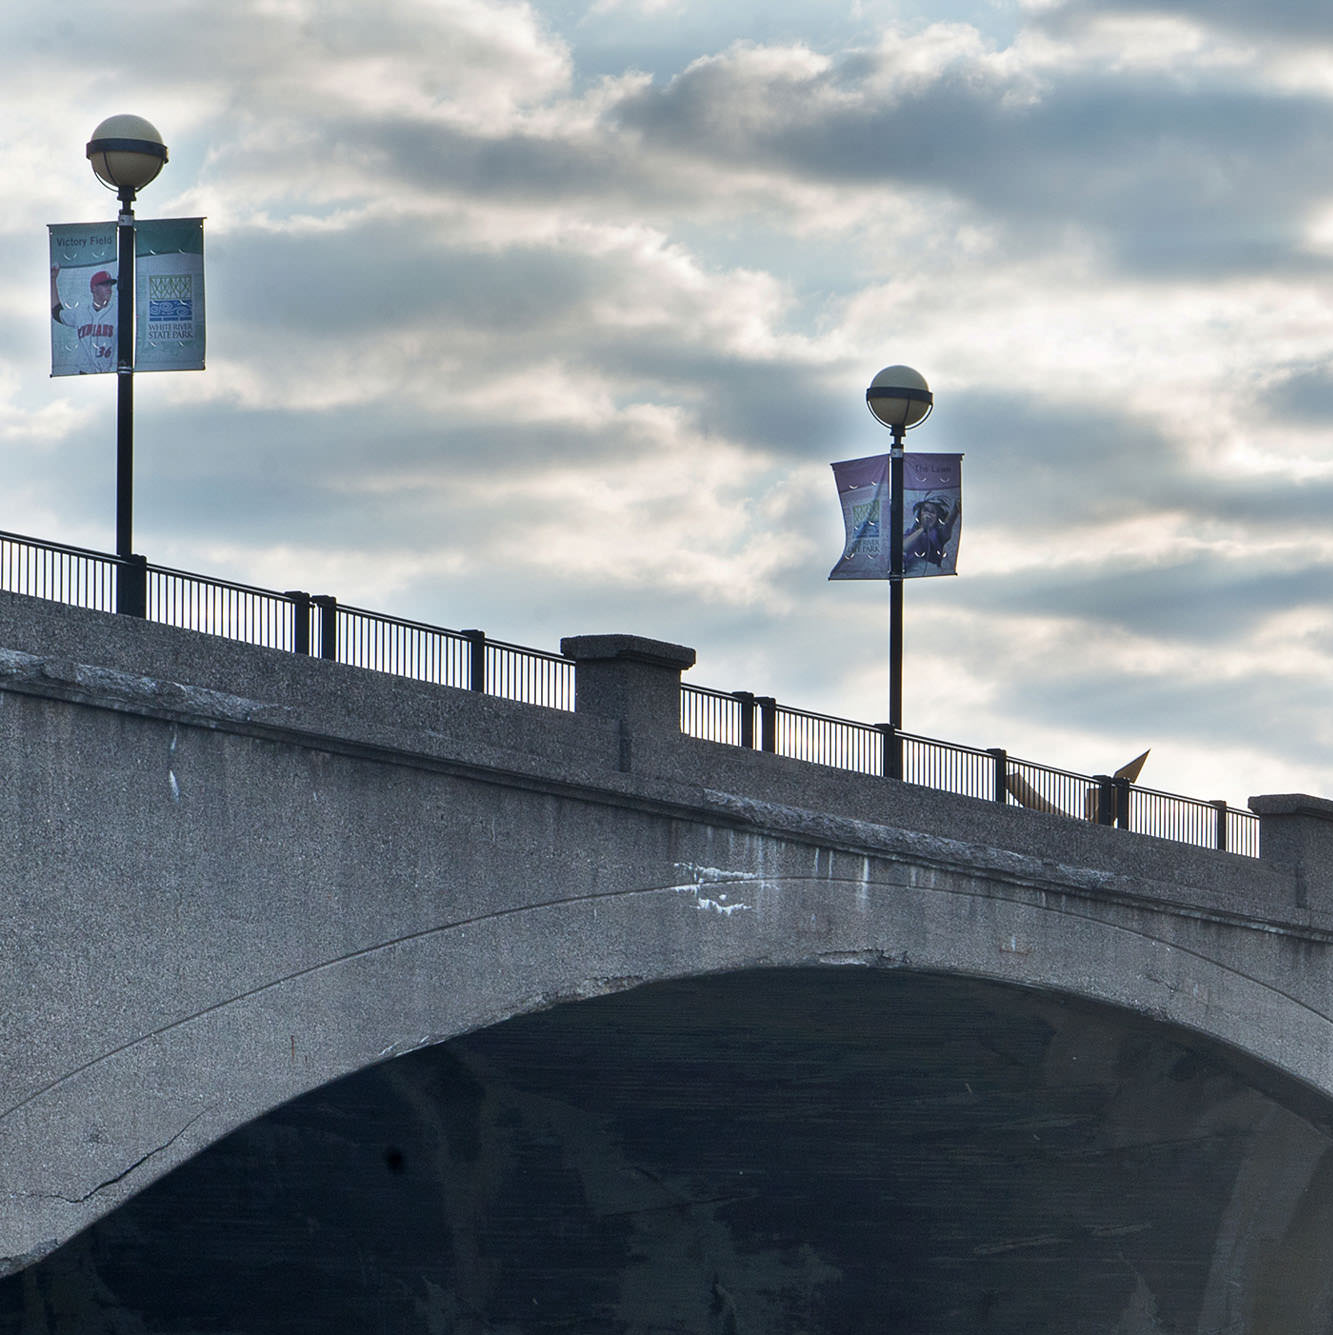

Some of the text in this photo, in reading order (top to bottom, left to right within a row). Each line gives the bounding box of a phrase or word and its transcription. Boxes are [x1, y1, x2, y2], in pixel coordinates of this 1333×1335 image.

[56, 235, 113, 248] Victory Field
[78, 323, 114, 339] INDIANS
[173, 322, 193, 330] RIVER
[148, 330, 194, 339] STATE PARK
[97, 346, 112, 358] 36
